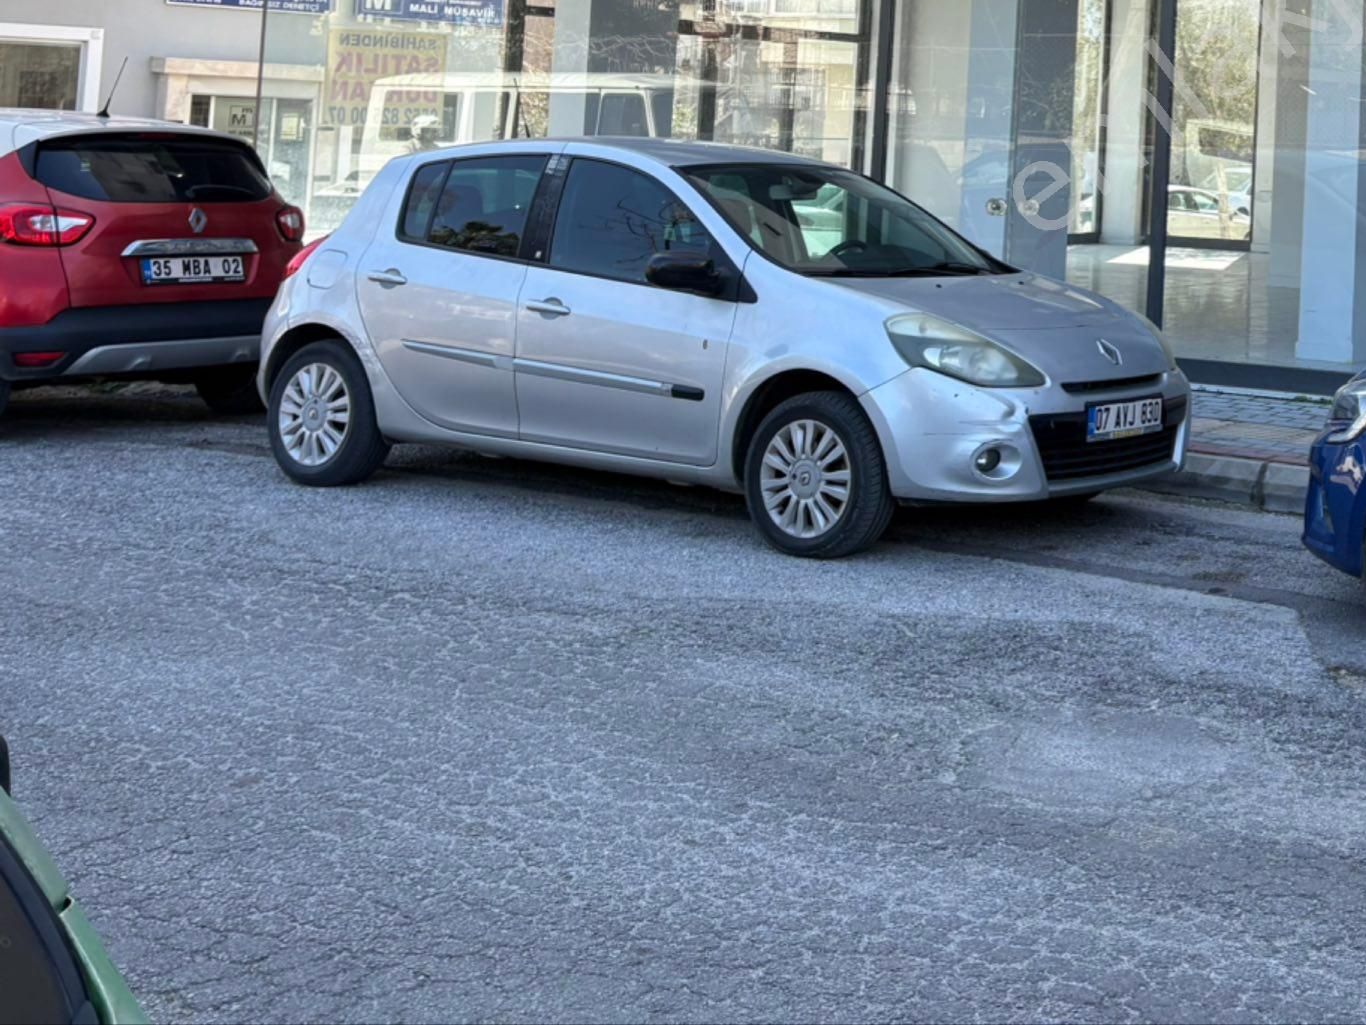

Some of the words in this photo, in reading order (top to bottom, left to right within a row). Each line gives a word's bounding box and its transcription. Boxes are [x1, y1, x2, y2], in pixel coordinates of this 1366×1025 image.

[409, 2, 438, 14] MALİ
[152, 260, 172, 277] 35
[181, 258, 212, 276] MBA
[221, 258, 241, 275] 02
[1096, 406, 1111, 431] 07
[1114, 403, 1137, 429] AYJ
[1140, 400, 1159, 425] 830
